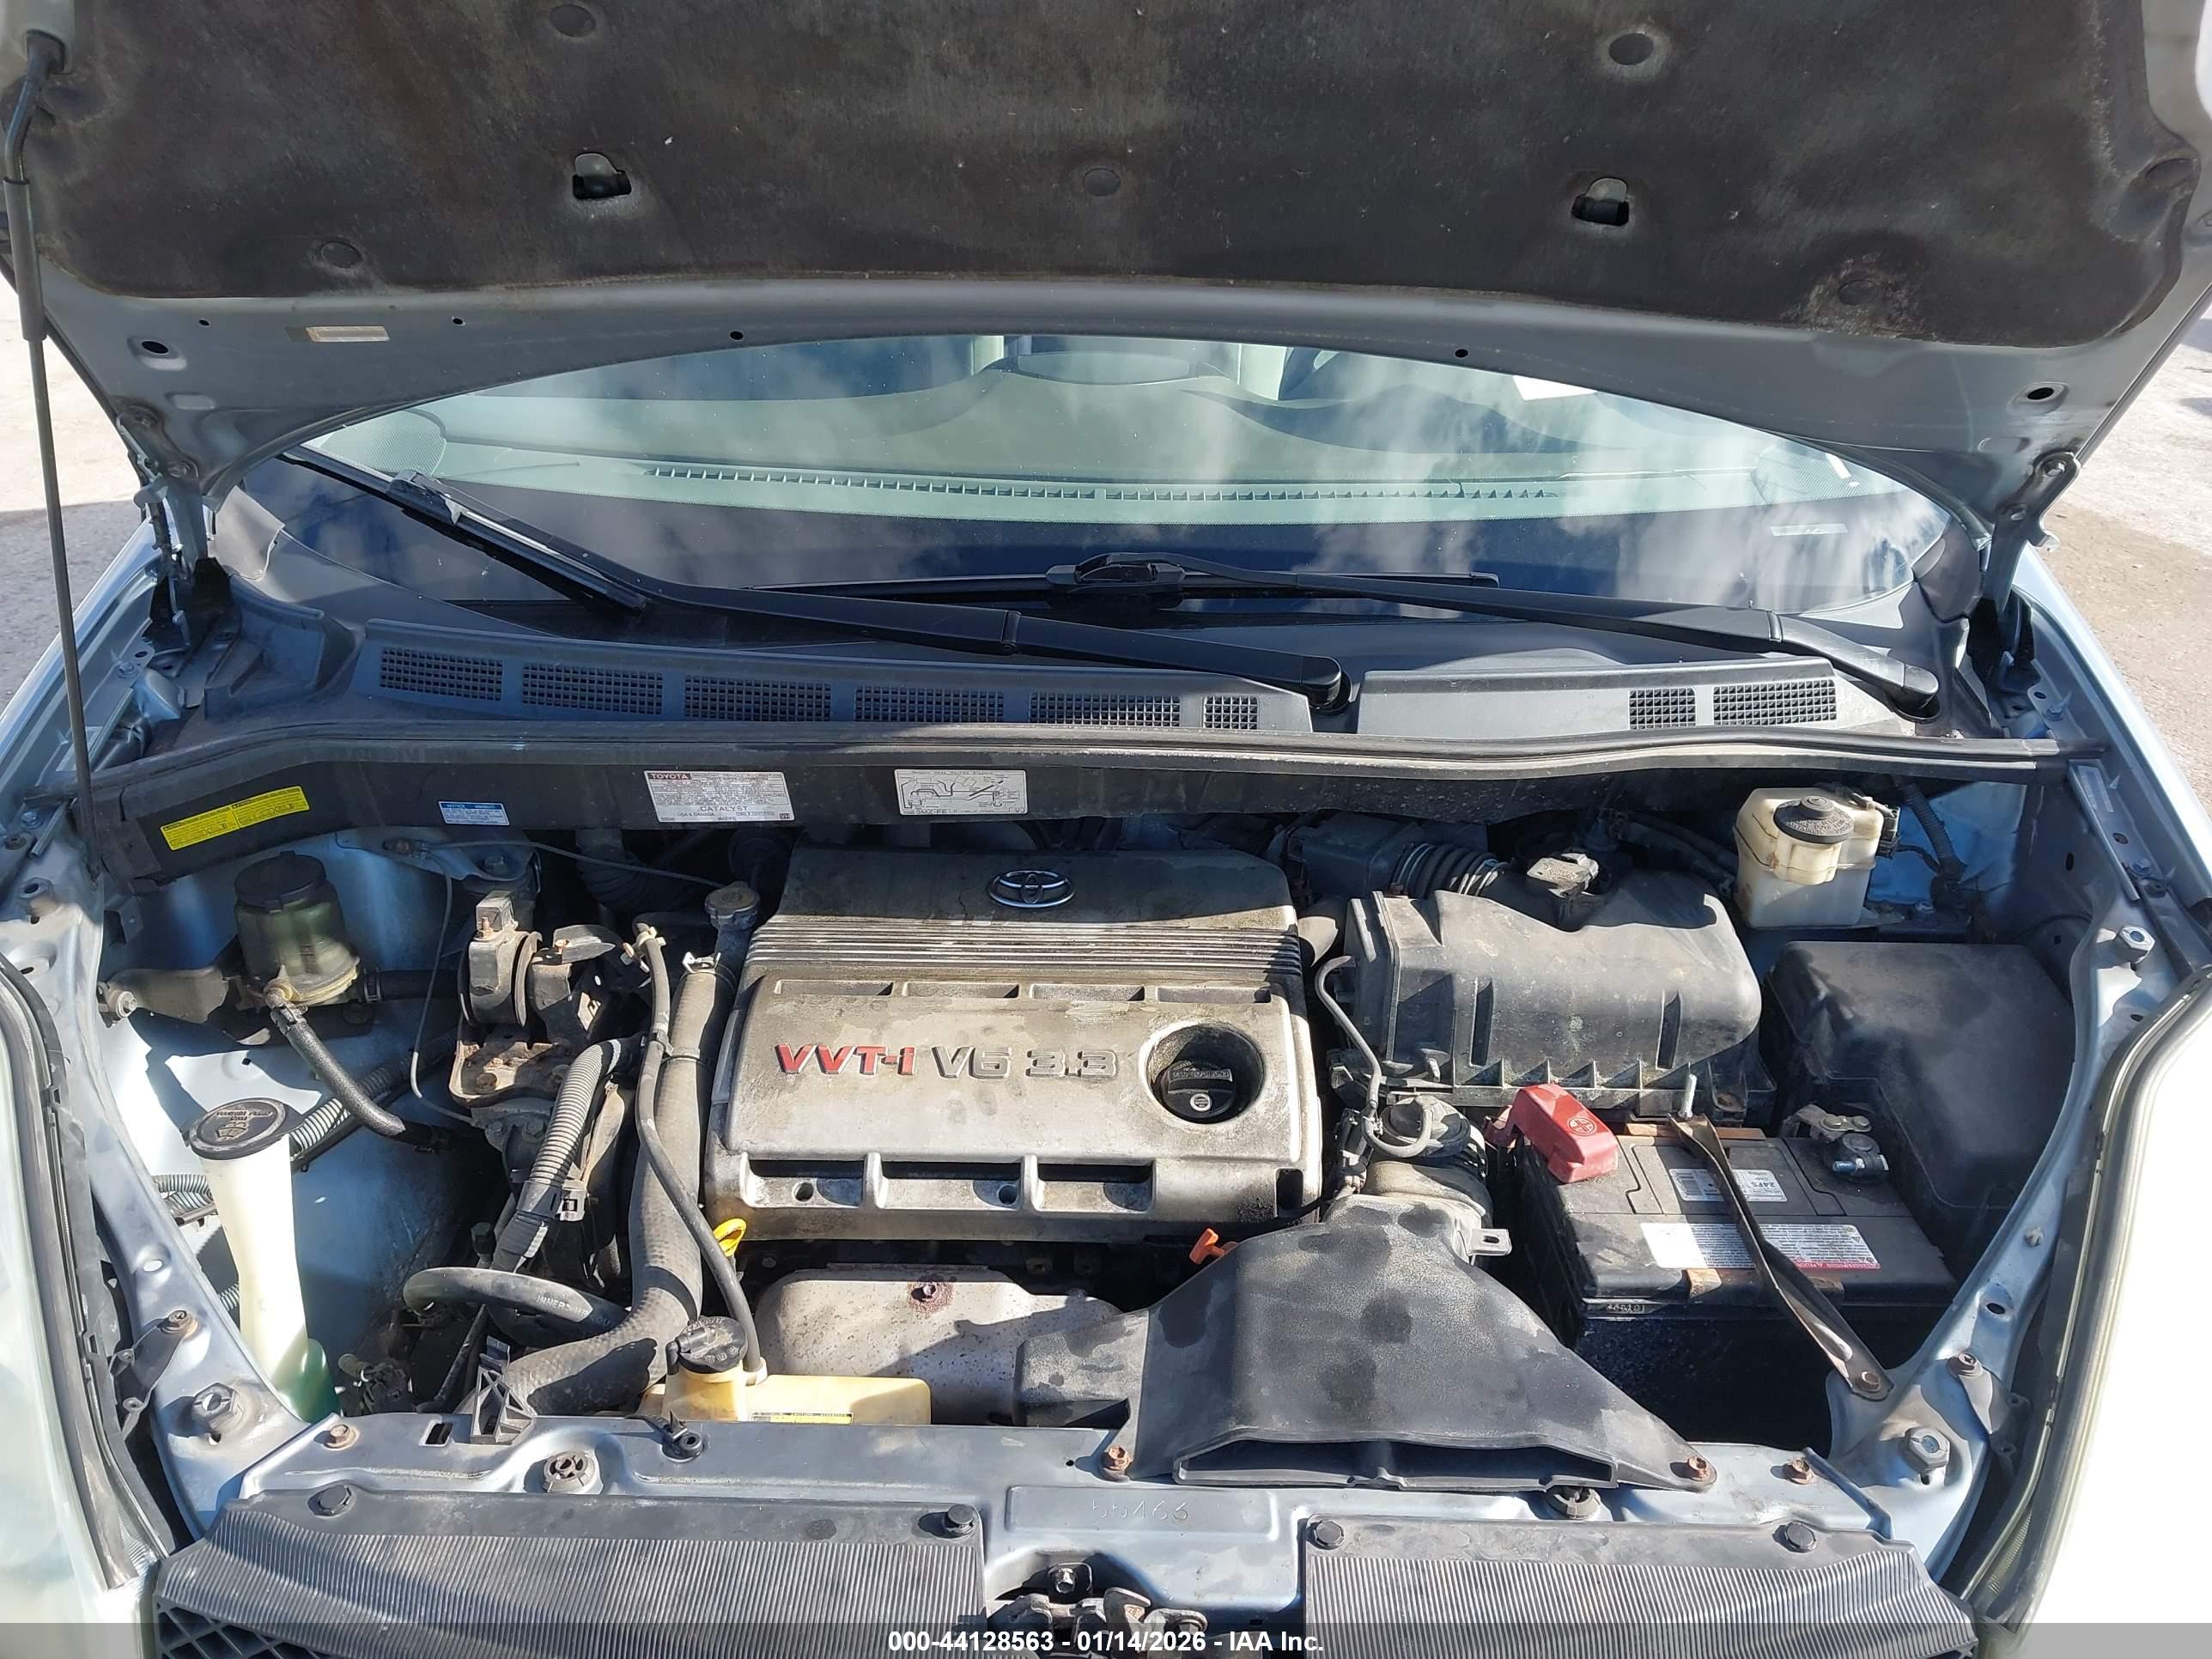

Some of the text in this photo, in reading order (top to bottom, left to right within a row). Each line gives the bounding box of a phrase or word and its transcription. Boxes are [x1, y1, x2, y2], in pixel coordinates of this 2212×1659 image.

[775, 1042, 1117, 1079] VVT-i V6 3.3
